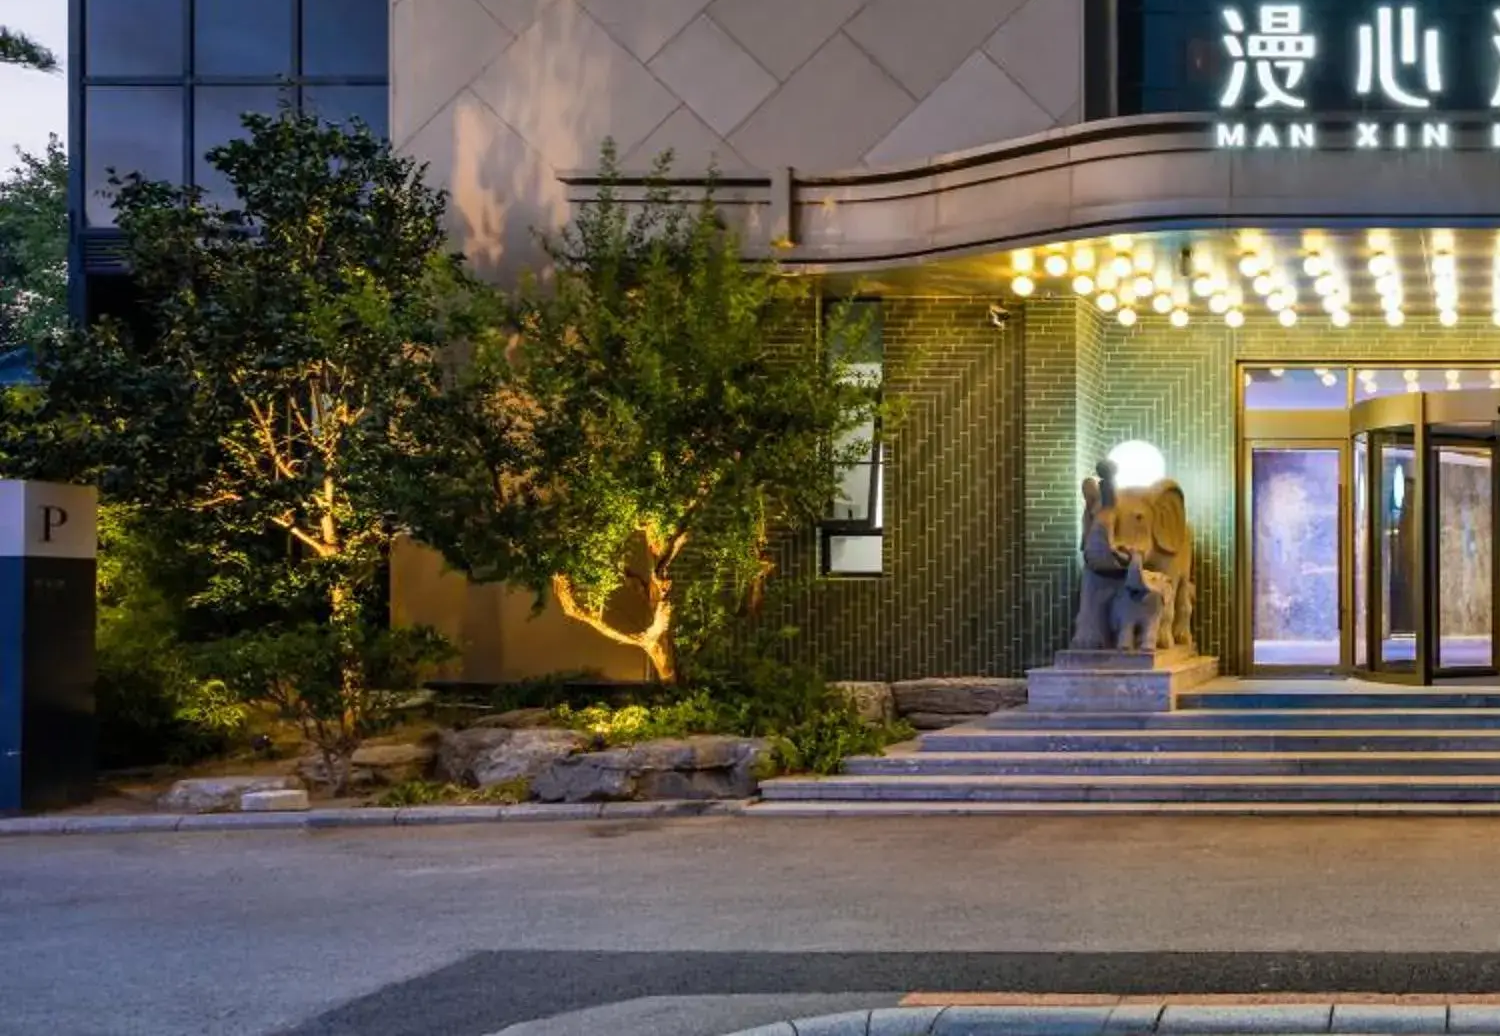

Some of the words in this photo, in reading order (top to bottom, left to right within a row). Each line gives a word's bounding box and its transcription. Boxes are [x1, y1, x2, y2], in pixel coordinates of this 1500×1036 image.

[1216, 123, 1316, 148] MAN
[1355, 122, 1449, 148] XIN
[39, 504, 69, 544] P
